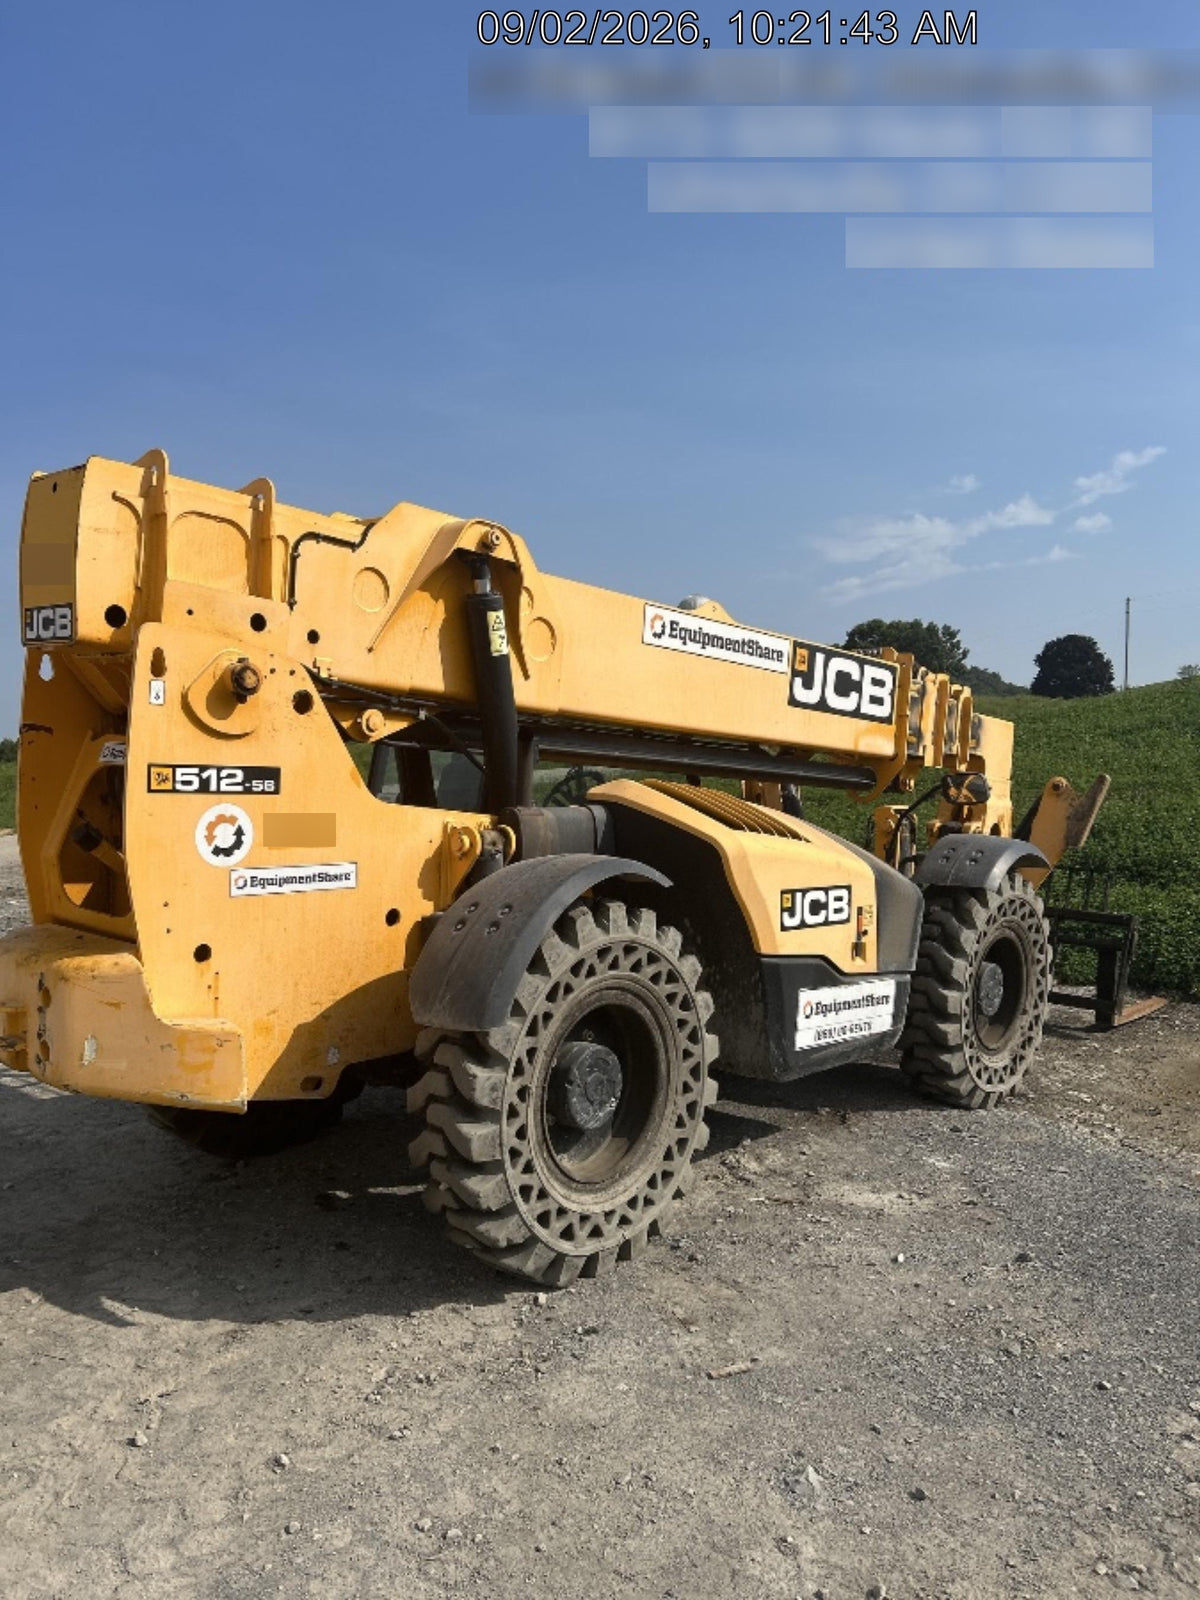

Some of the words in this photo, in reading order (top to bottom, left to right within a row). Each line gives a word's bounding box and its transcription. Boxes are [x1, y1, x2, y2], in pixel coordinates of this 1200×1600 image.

[26, 607, 72, 639] JCB
[668, 620, 784, 663] EquipmentShare
[793, 651, 894, 718] JCB
[250, 872, 351, 889] EquipmentShare
[782, 888, 850, 927] JCB
